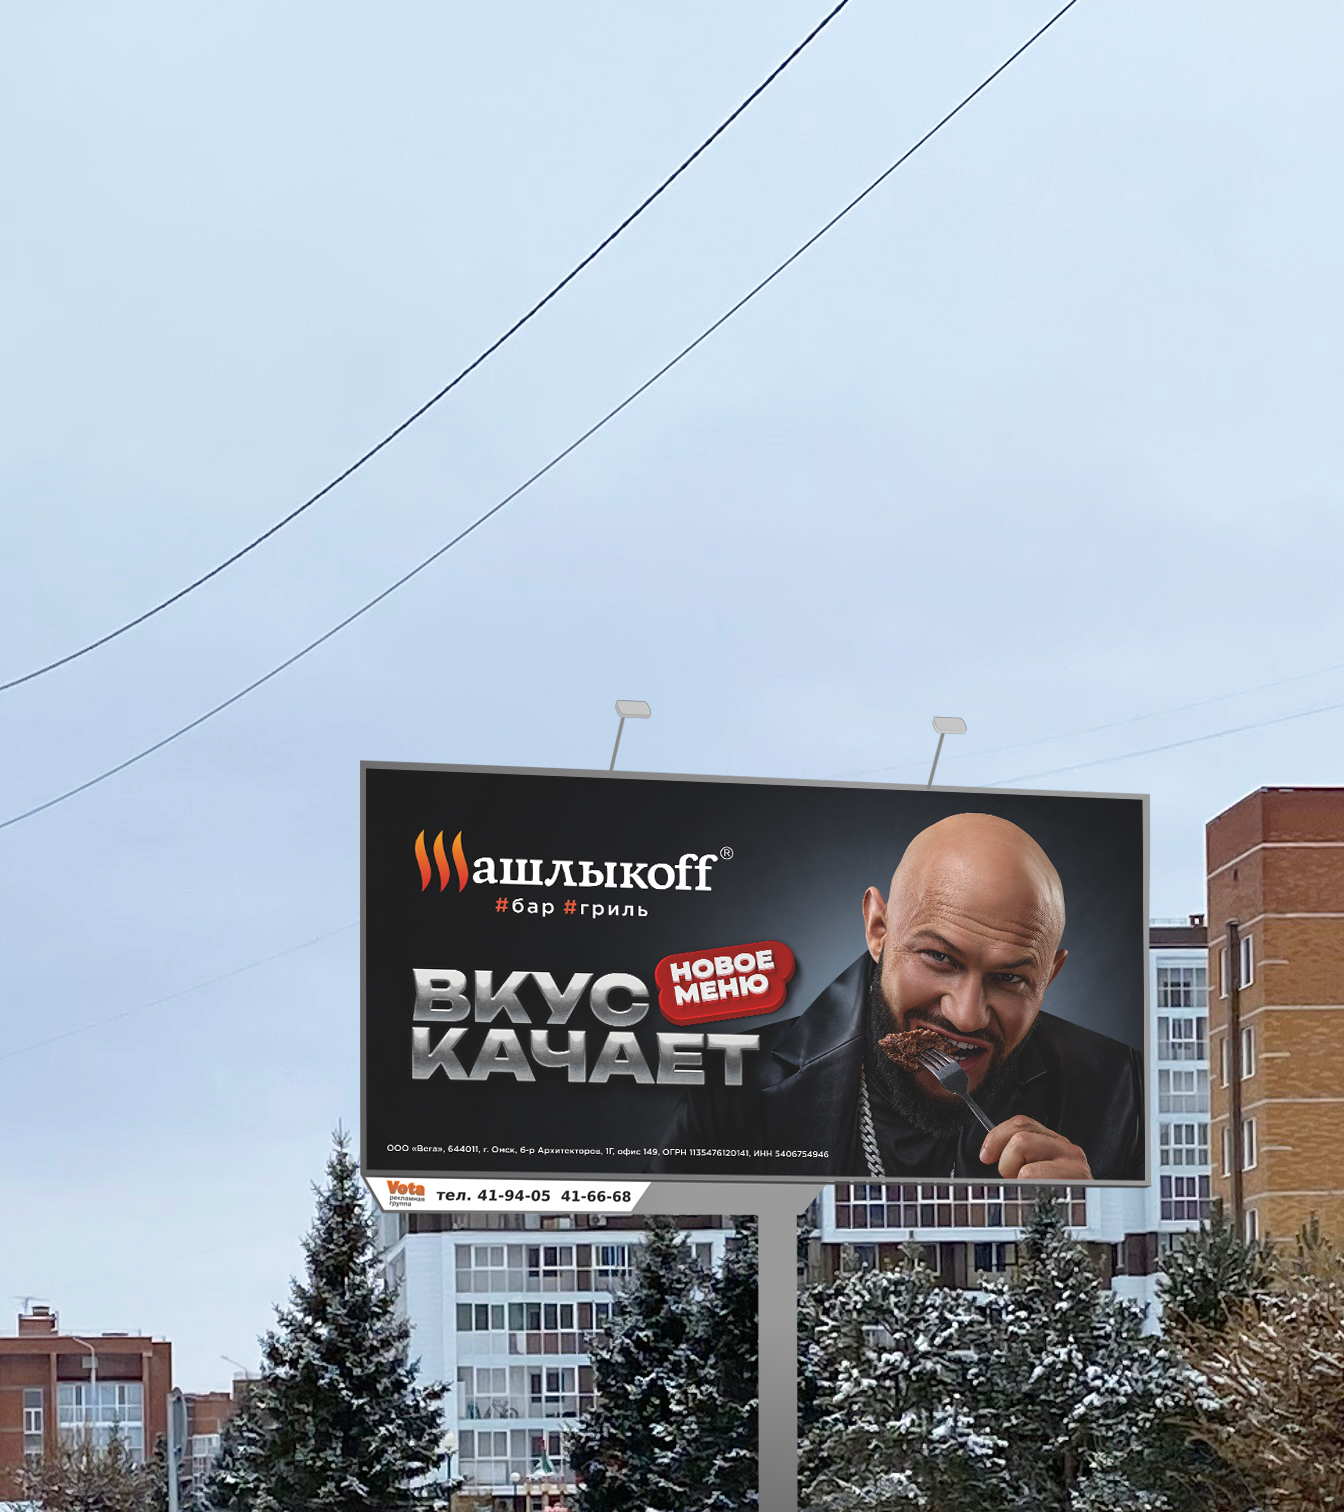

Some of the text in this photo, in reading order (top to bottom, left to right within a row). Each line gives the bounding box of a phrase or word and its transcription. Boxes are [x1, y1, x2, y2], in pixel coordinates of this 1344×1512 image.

[495, 897, 649, 918] #бар #гриль
[669, 948, 775, 985] НОВОЕ
[412, 968, 650, 1027] ВКУС
[673, 973, 769, 1006] МЕНЮ
[411, 1026, 760, 1086] КАЧАЕТ
[386, 1144, 409, 1152] ООО
[447, 1144, 481, 1154] 644011,
[491, 1146, 517, 1154] Омск,
[519, 1146, 535, 1155] б-р
[537, 1146, 603, 1156] Архитекторов,
[617, 1147, 641, 1157] офис
[643, 1148, 660, 1157] 149,
[662, 1148, 687, 1156] ОГРН
[689, 1149, 751, 1158] 1135476120141,
[775, 1150, 829, 1158] 5406754946
[386, 1180, 425, 1196] Vota
[436, 1189, 632, 1203] тел. 41-94-05 41-66-68
[389, 1195, 425, 1203] рекламная
